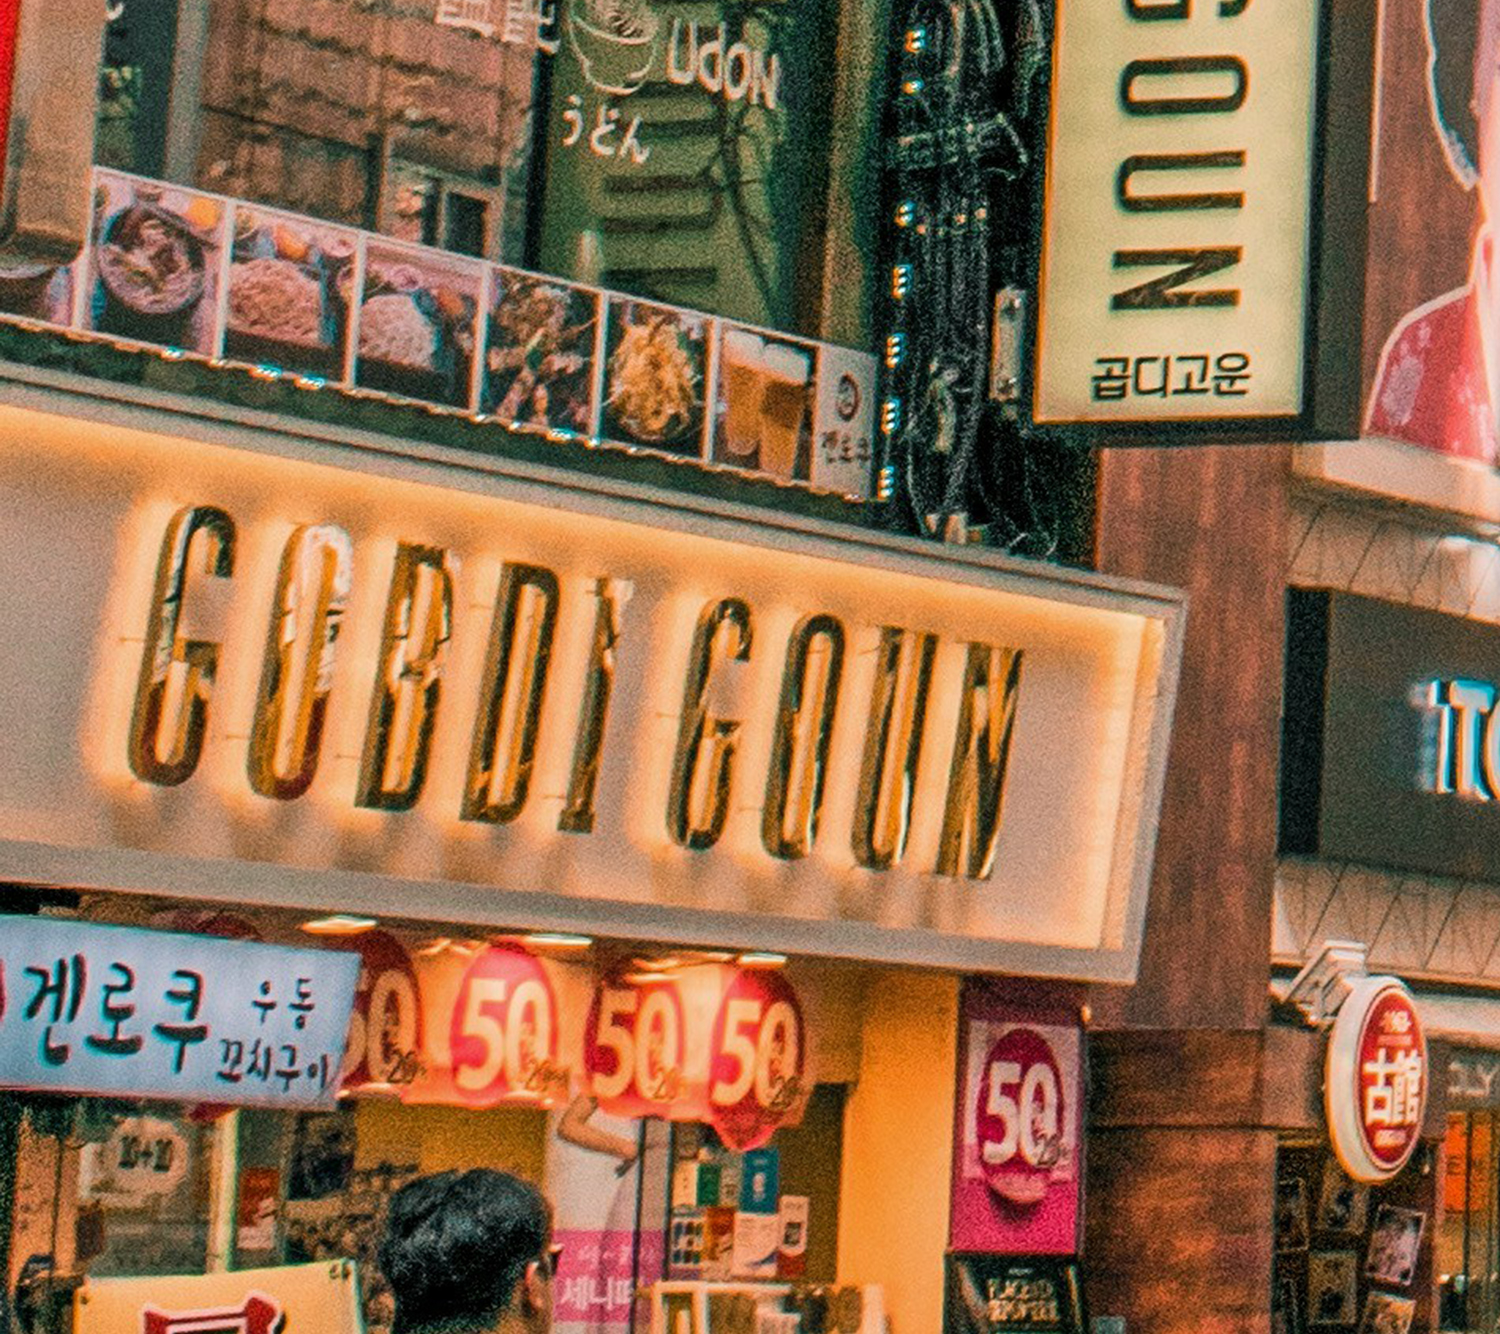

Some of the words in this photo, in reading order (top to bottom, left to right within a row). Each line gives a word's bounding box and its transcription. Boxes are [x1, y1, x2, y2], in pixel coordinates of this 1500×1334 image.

[561, 92, 652, 167] うどん
[1090, 351, 1253, 401] 곱디고운
[122, 503, 635, 835] GOBDI
[665, 596, 1029, 880] GOUN
[22, 952, 211, 1081] 겐로쿠
[250, 976, 316, 1034] 우동
[455, 976, 554, 1092] 50
[592, 989, 681, 1101] 50
[710, 999, 801, 1108] 50
[217, 1037, 333, 1093] 꼬치구이
[981, 1060, 1060, 1168] 50
